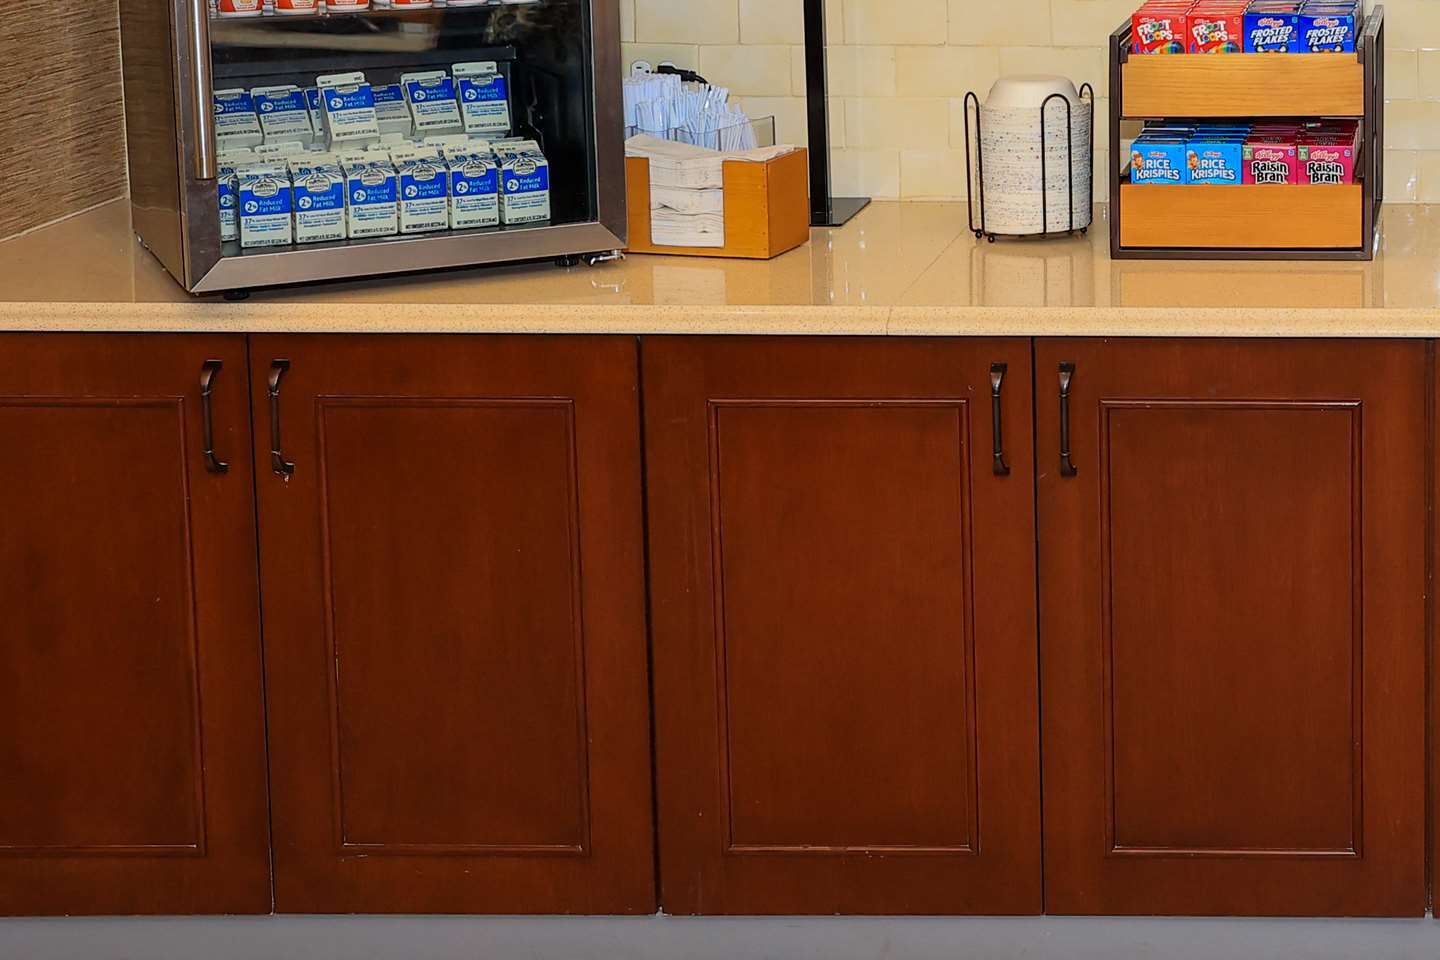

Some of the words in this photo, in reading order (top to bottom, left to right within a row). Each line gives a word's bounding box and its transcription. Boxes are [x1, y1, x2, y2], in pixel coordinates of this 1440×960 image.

[1137, 19, 1171, 37] FROOT
[1192, 20, 1226, 38] FROOT
[1251, 26, 1293, 39] FROSTED
[1306, 26, 1348, 39] FROSTED
[1141, 30, 1173, 45] LOOPS
[1196, 31, 1228, 46] LOOPS
[1253, 34, 1288, 46] FLAKES
[1308, 34, 1344, 46] FLAKES
[1146, 159, 1170, 169] RICE
[1201, 159, 1225, 169] RICE
[1252, 161, 1288, 174] Raisin
[1307, 161, 1343, 174] Raisin
[1136, 169, 1180, 180] KRISPIES
[1191, 169, 1235, 180] KRISPIES
[1256, 172, 1284, 182] Bran
[1311, 172, 1339, 182] Bran
